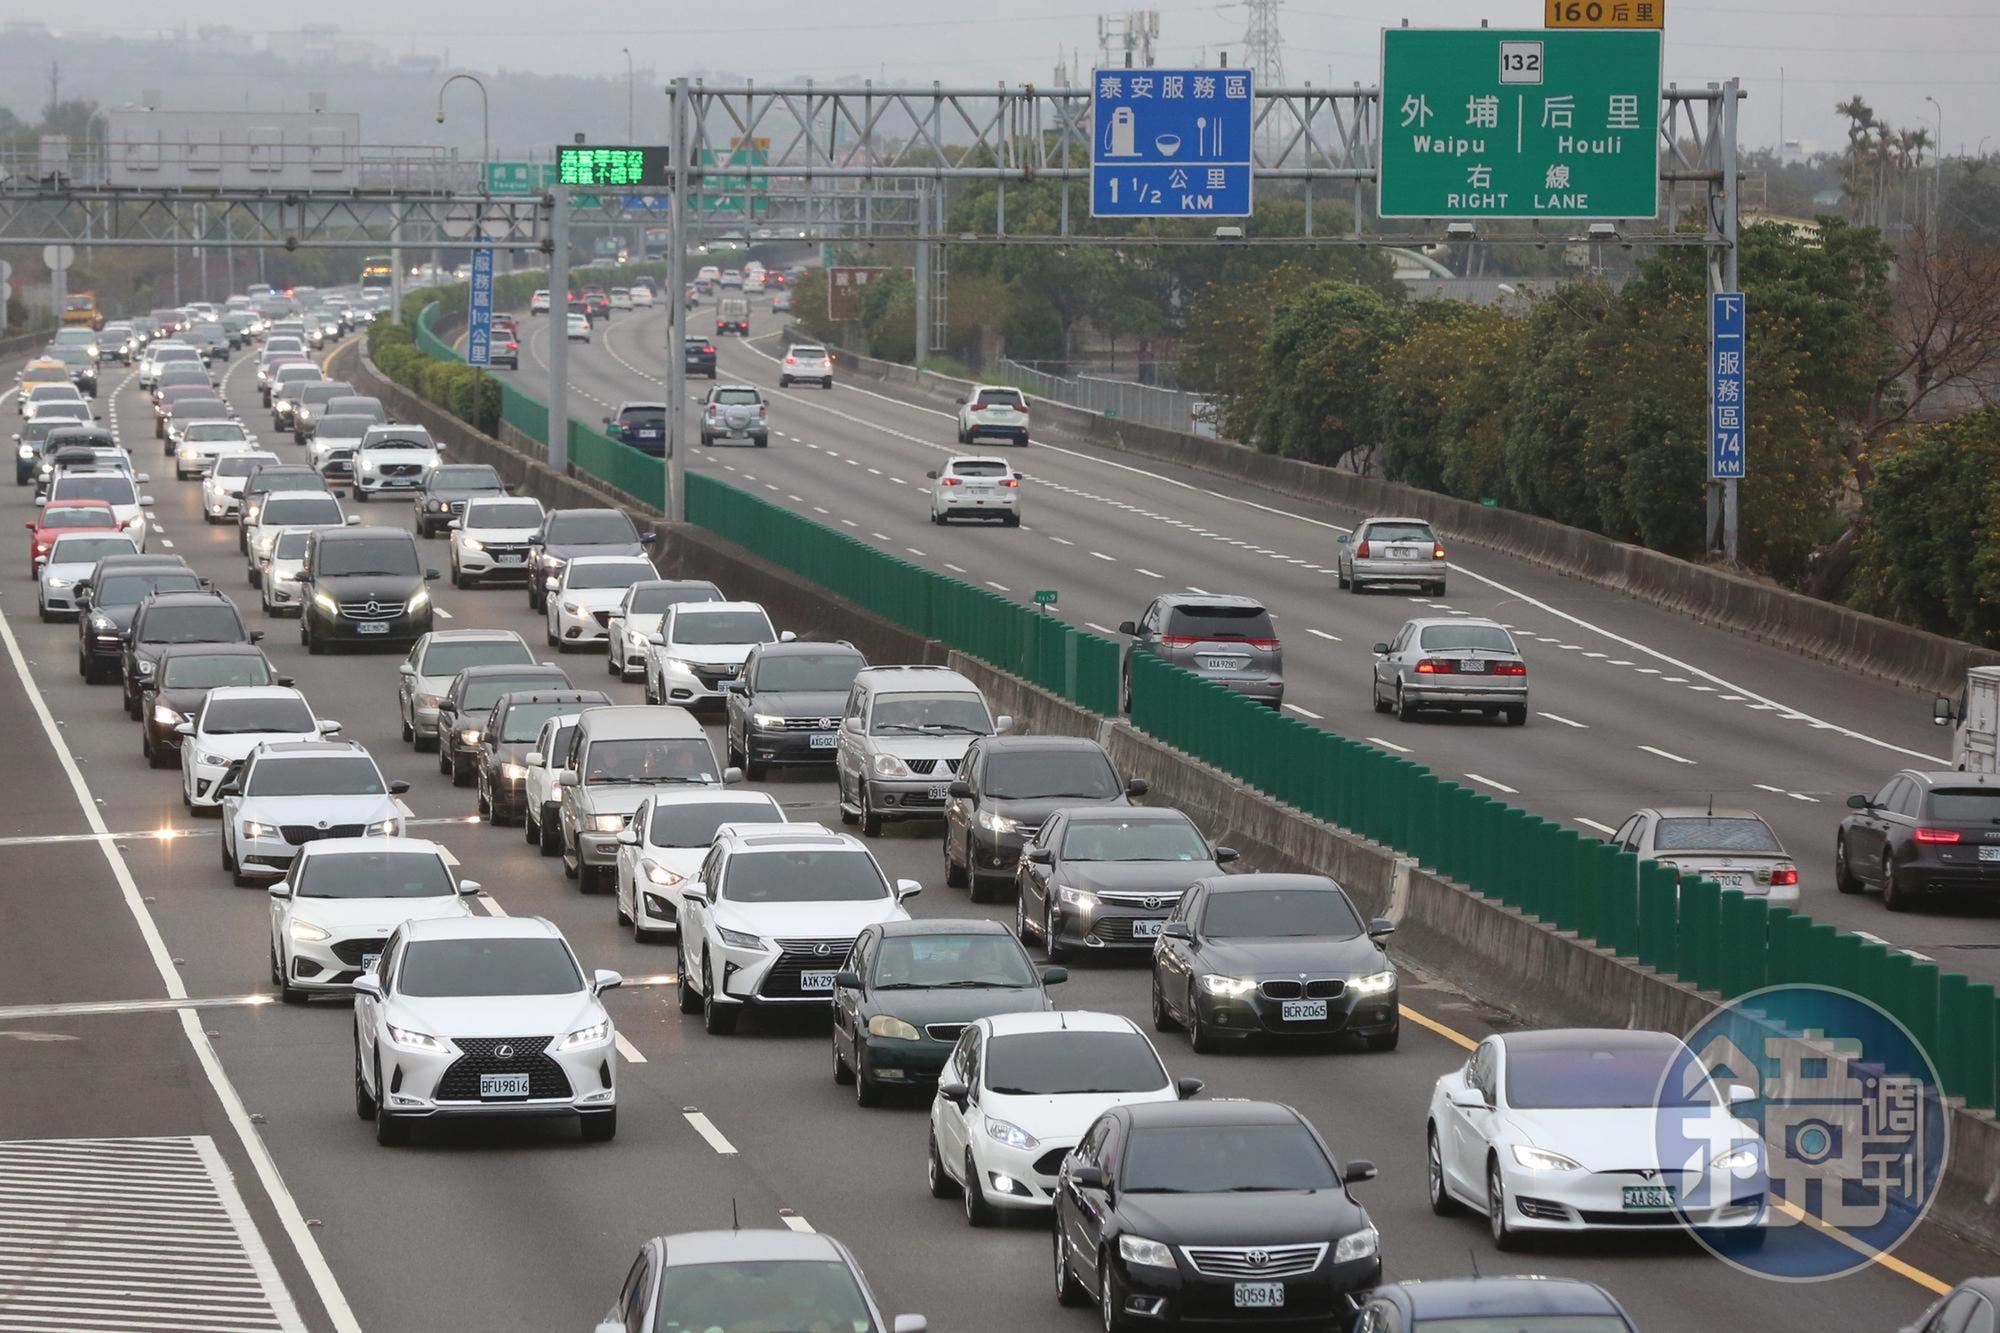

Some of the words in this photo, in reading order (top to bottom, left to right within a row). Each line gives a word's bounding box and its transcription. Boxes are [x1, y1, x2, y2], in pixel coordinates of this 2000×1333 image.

[1553, 2, 1603, 22] 160
[1611, 4, 1654, 22] 后里
[1503, 54, 1540, 71] 132
[1100, 76, 1247, 99] 泰安服務區
[1400, 94, 1499, 129] 外埔
[1541, 95, 1640, 129] 后里
[1413, 135, 1486, 157] Waipu
[1558, 136, 1622, 154] Houli
[1168, 169, 1226, 189] 公里
[1466, 164, 1570, 189] 右線
[1181, 194, 1213, 210] KM
[1447, 194, 1508, 209] RIGHT
[1534, 194, 1588, 209] LANE
[1717, 297, 1740, 429] 下一服務區
[1717, 433, 1740, 456] 74
[1718, 460, 1740, 473] KM
[929, 788, 947, 798] 0915
[802, 975, 837, 988] AXK-29
